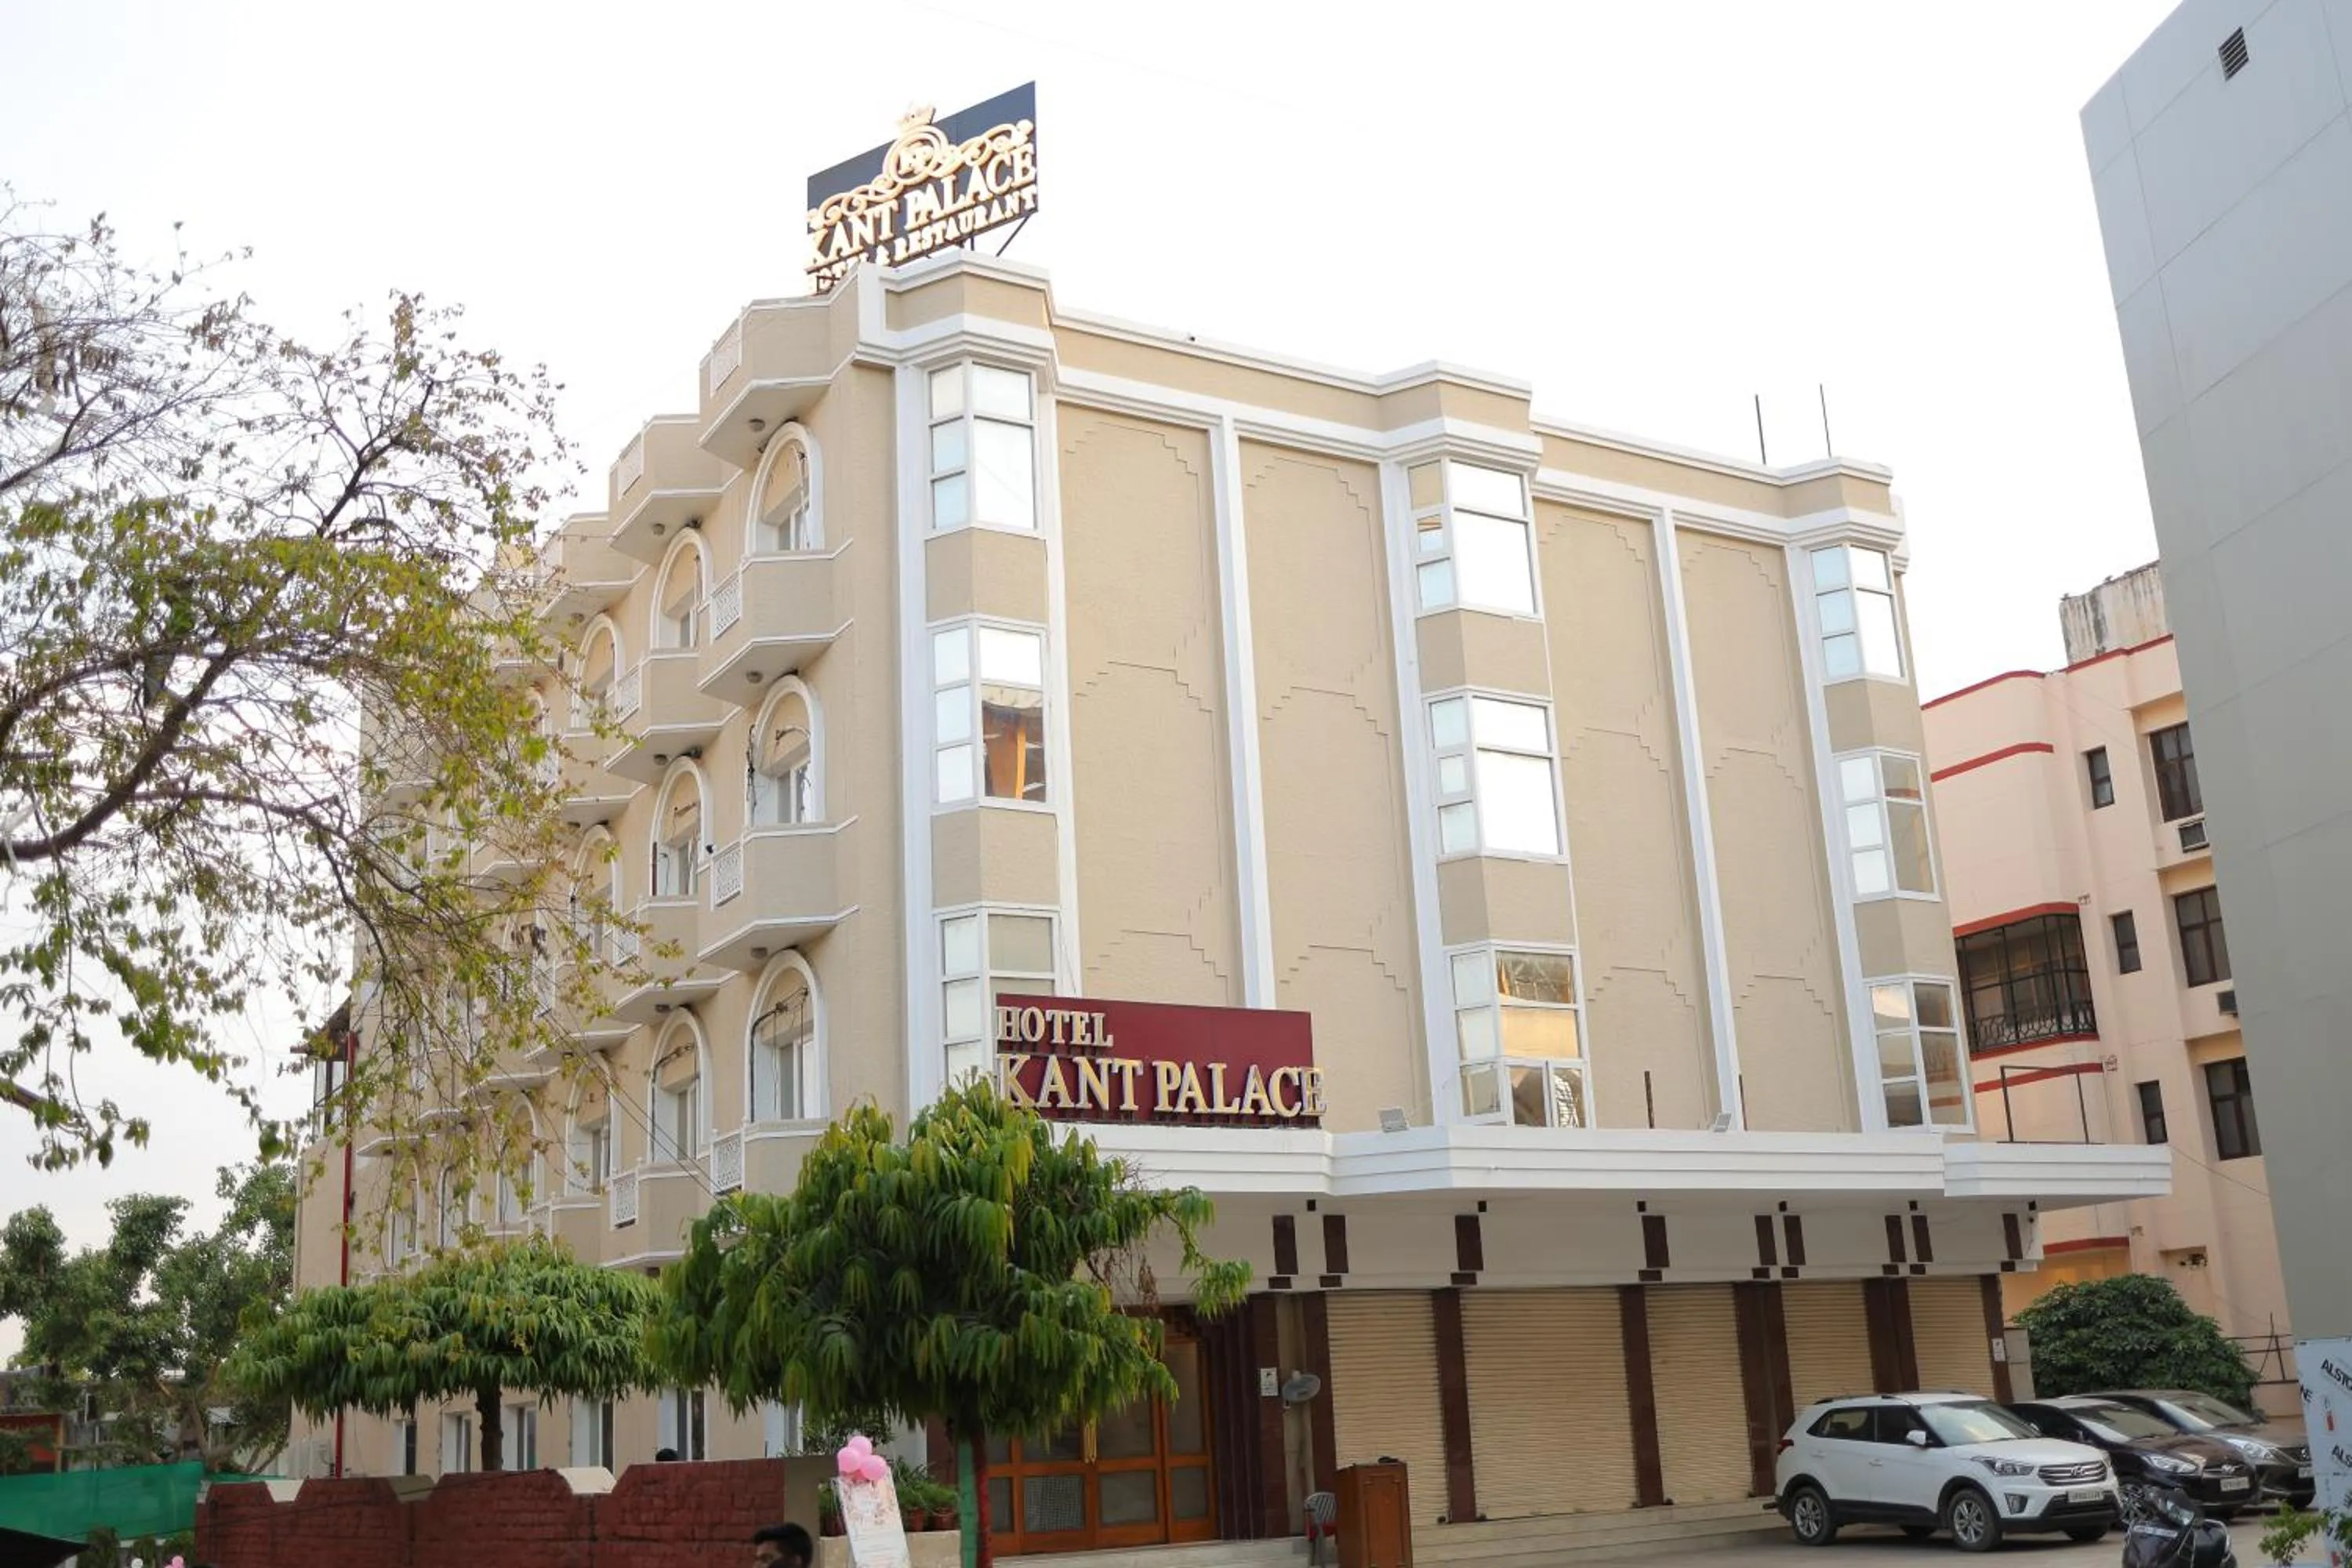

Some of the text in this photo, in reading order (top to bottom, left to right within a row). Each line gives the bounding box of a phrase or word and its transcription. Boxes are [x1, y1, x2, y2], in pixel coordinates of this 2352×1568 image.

[804, 143, 1036, 273] KANT PALACE
[895, 184, 1036, 261] RESTAURANT
[995, 1006, 1115, 1047] HOTEL
[996, 1052, 1328, 1119] KANT PALACE
